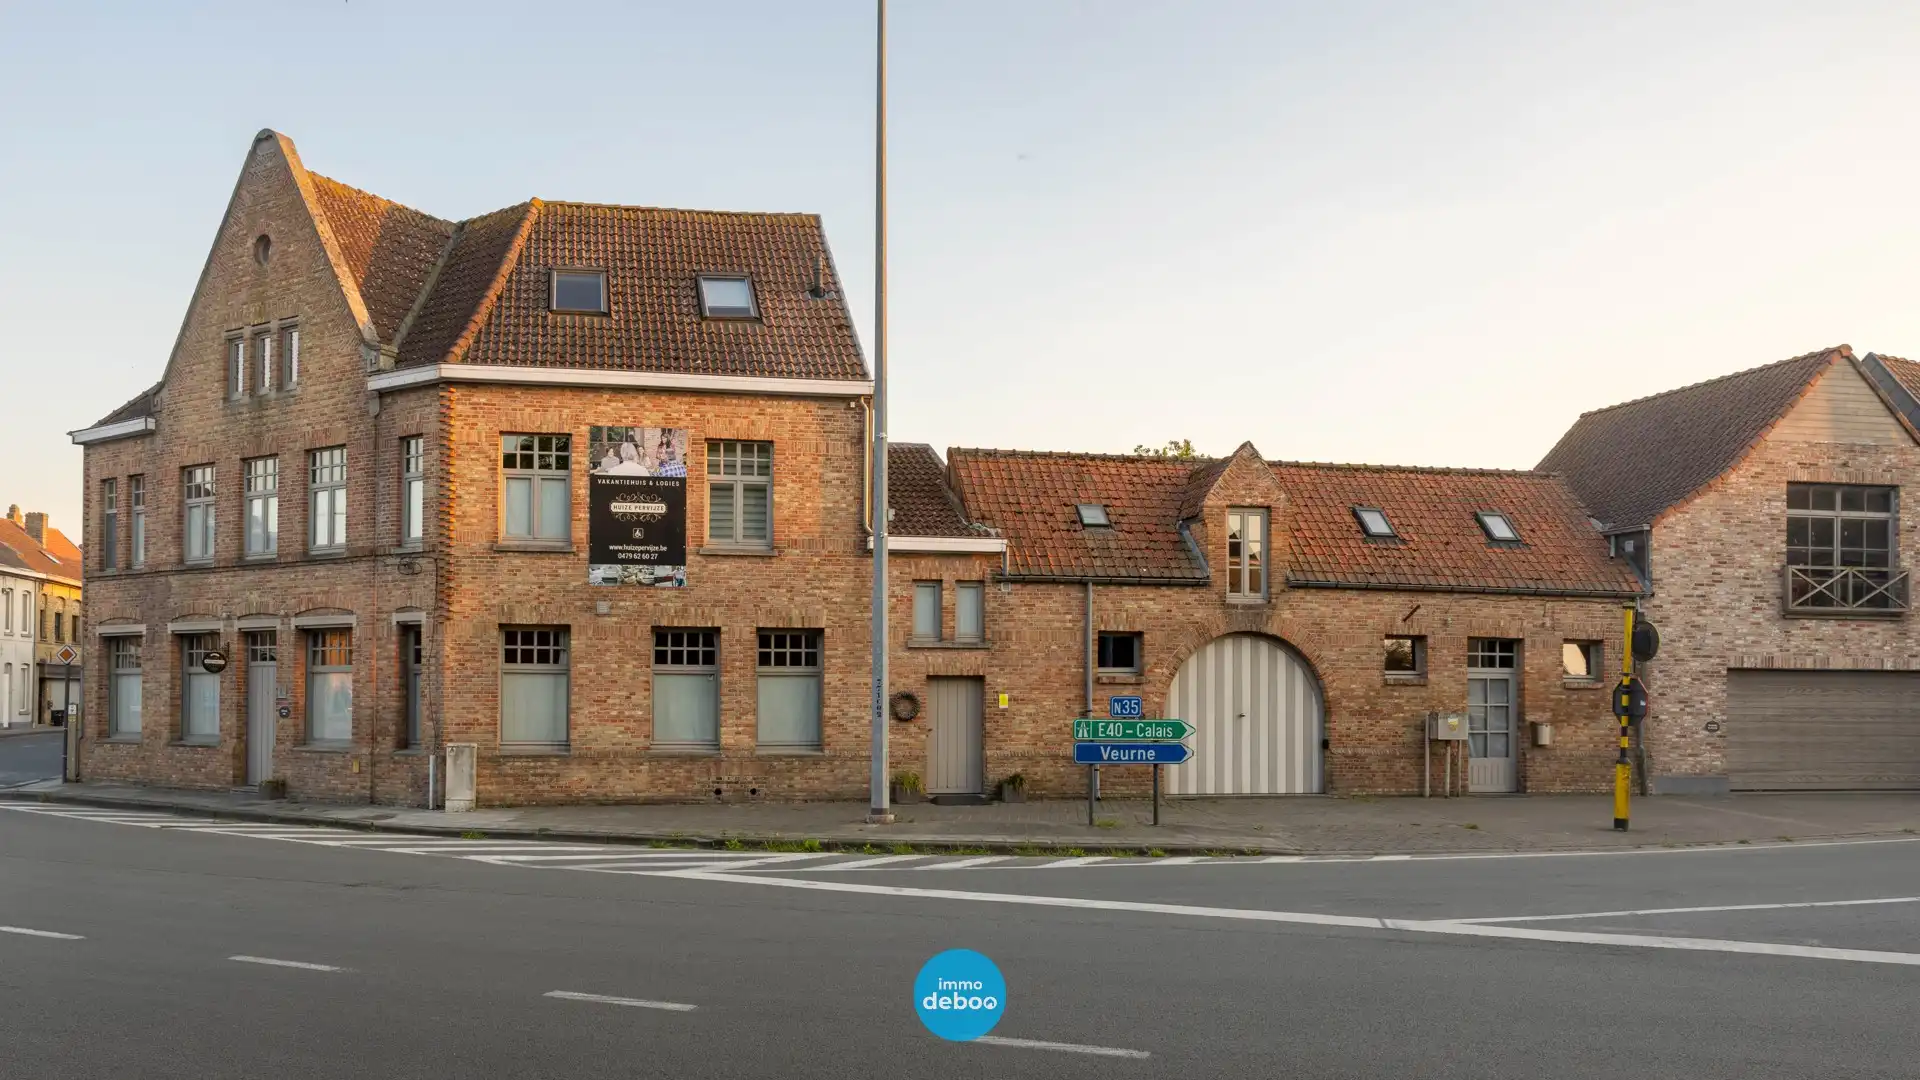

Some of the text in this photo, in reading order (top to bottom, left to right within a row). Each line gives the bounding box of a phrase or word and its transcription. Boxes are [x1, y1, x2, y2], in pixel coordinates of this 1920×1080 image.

[609, 544, 667, 552] www.huizepervijze.be
[1114, 700, 1138, 714] N35
[1098, 723, 1122, 737] E40
[1136, 723, 1173, 738] Calais
[1100, 746, 1156, 760] Veurne
